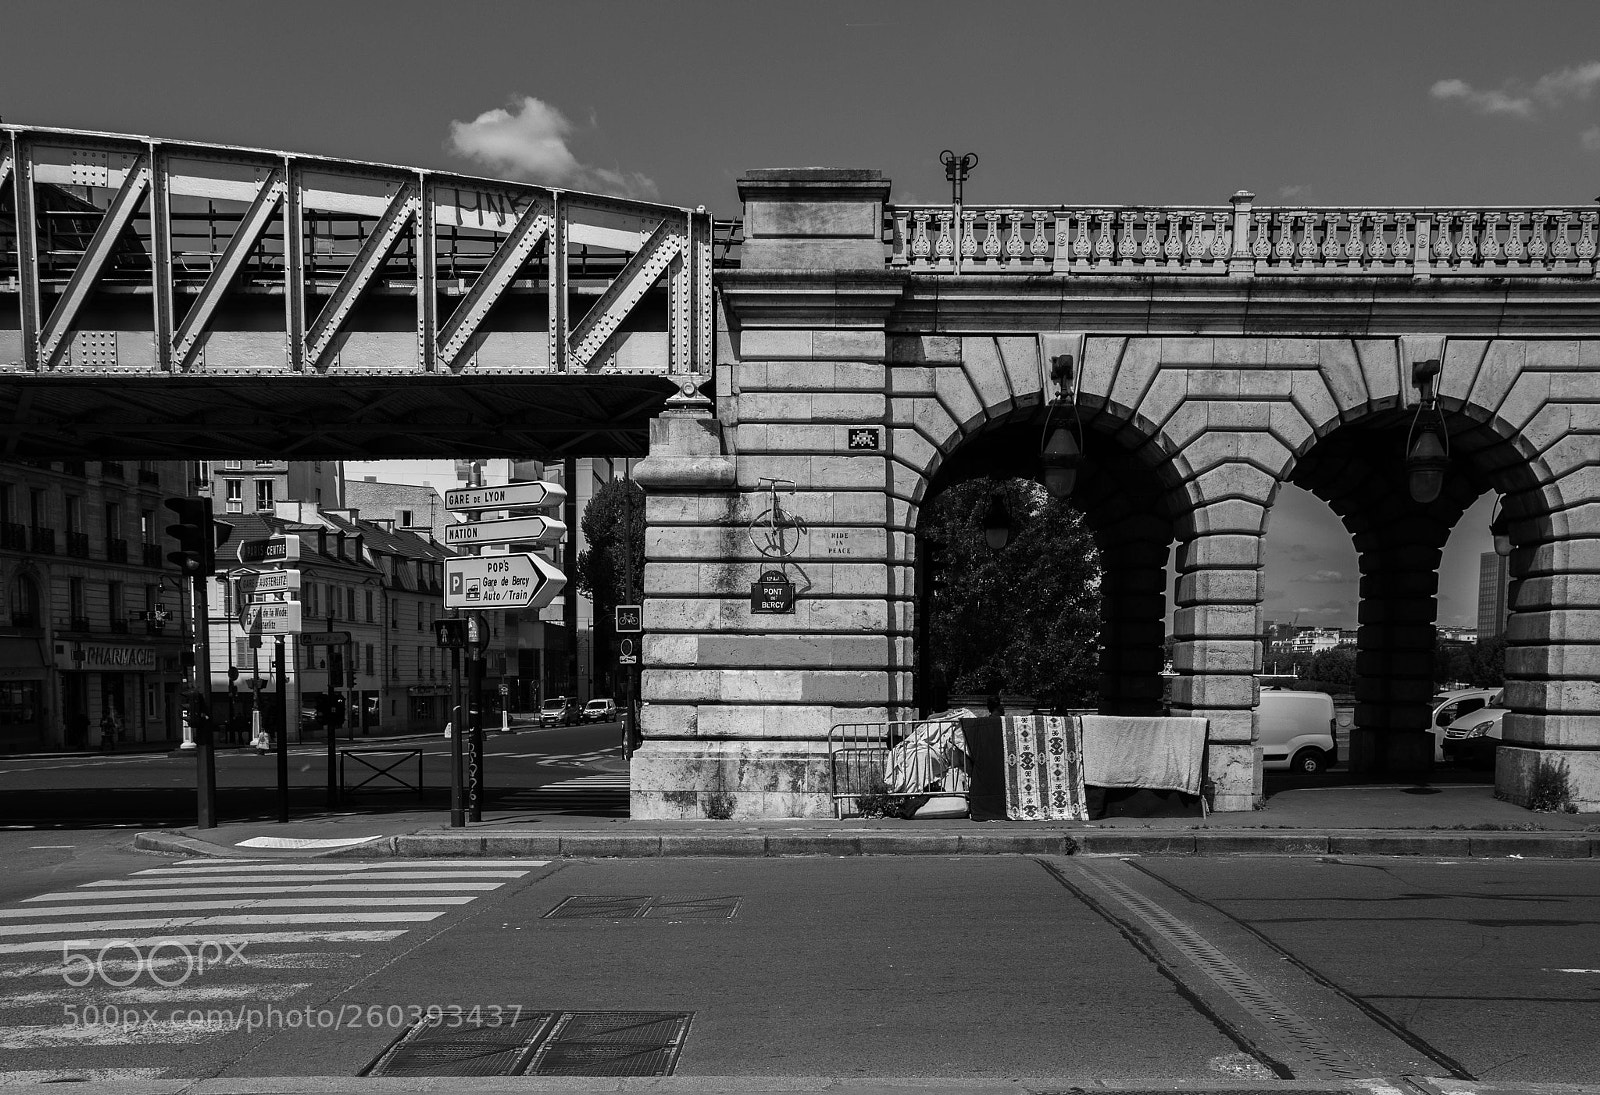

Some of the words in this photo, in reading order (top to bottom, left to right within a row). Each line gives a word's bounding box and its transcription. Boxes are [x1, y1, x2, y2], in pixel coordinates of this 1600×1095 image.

[448, 493, 471, 505] GARE
[484, 490, 506, 503] LYON
[449, 527, 478, 540] NATION
[266, 544, 286, 556] CENTRE
[452, 576, 460, 592] P
[482, 576, 498, 587] Gare
[500, 575, 509, 587] de
[511, 575, 530, 588] Bercy
[763, 588, 783, 596] PONT
[761, 601, 785, 609] BERCY
[87, 647, 155, 666] PHARMACIE
